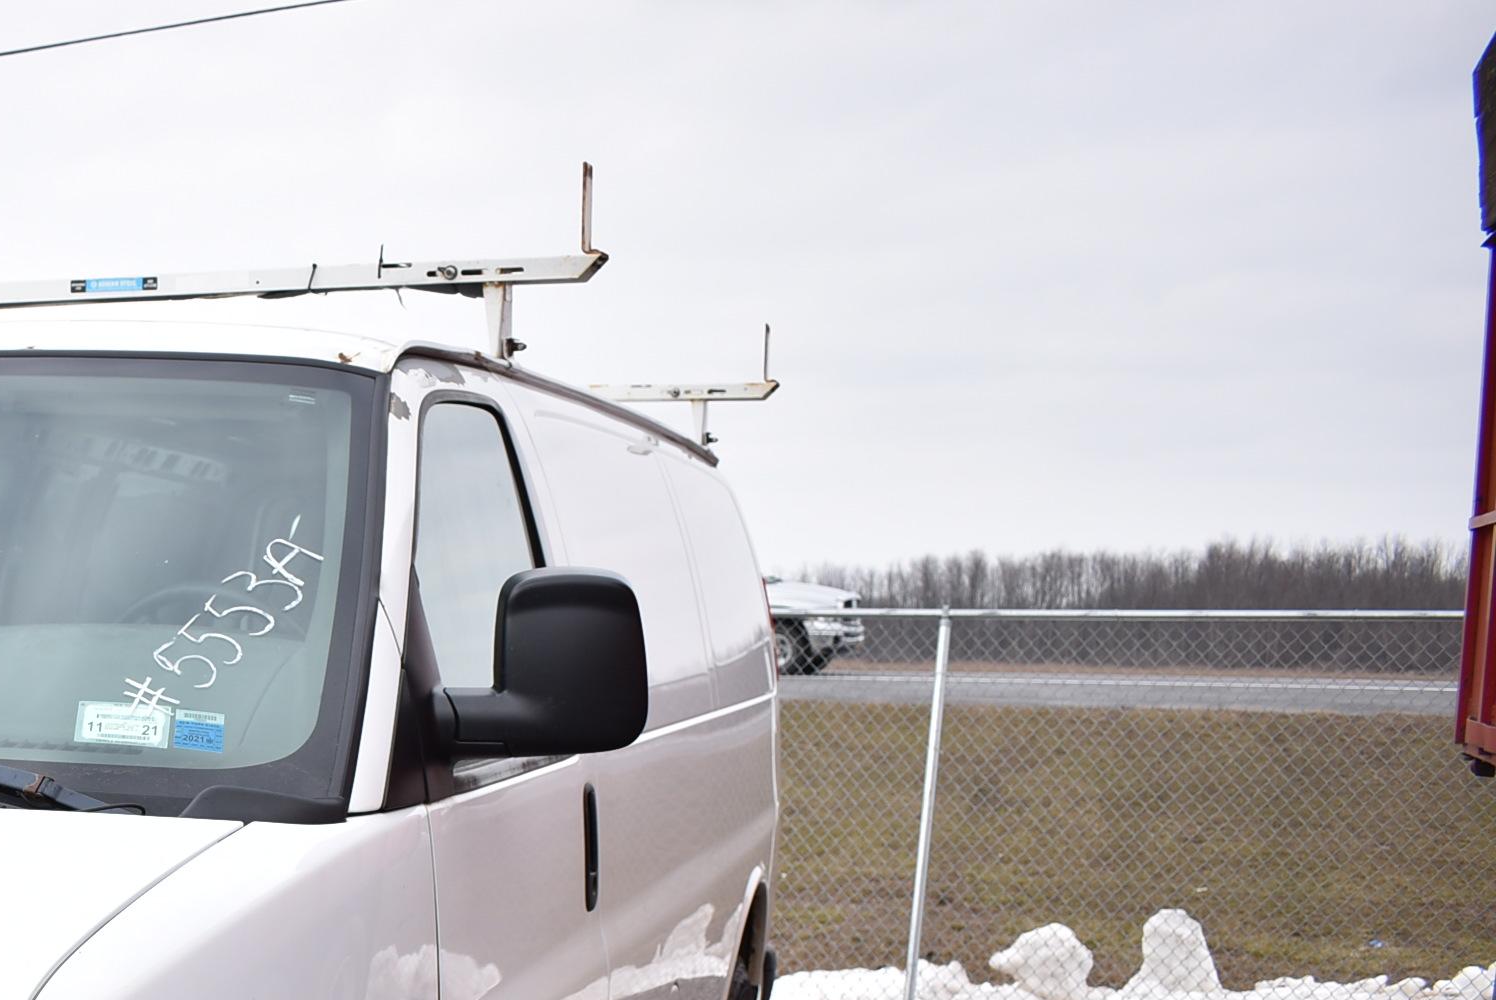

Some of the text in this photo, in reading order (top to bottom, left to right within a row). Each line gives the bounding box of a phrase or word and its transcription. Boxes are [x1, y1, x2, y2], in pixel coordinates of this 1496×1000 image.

[87, 721, 103, 733] 11
[141, 724, 158, 736] 21
[183, 734, 205, 744] 2021
